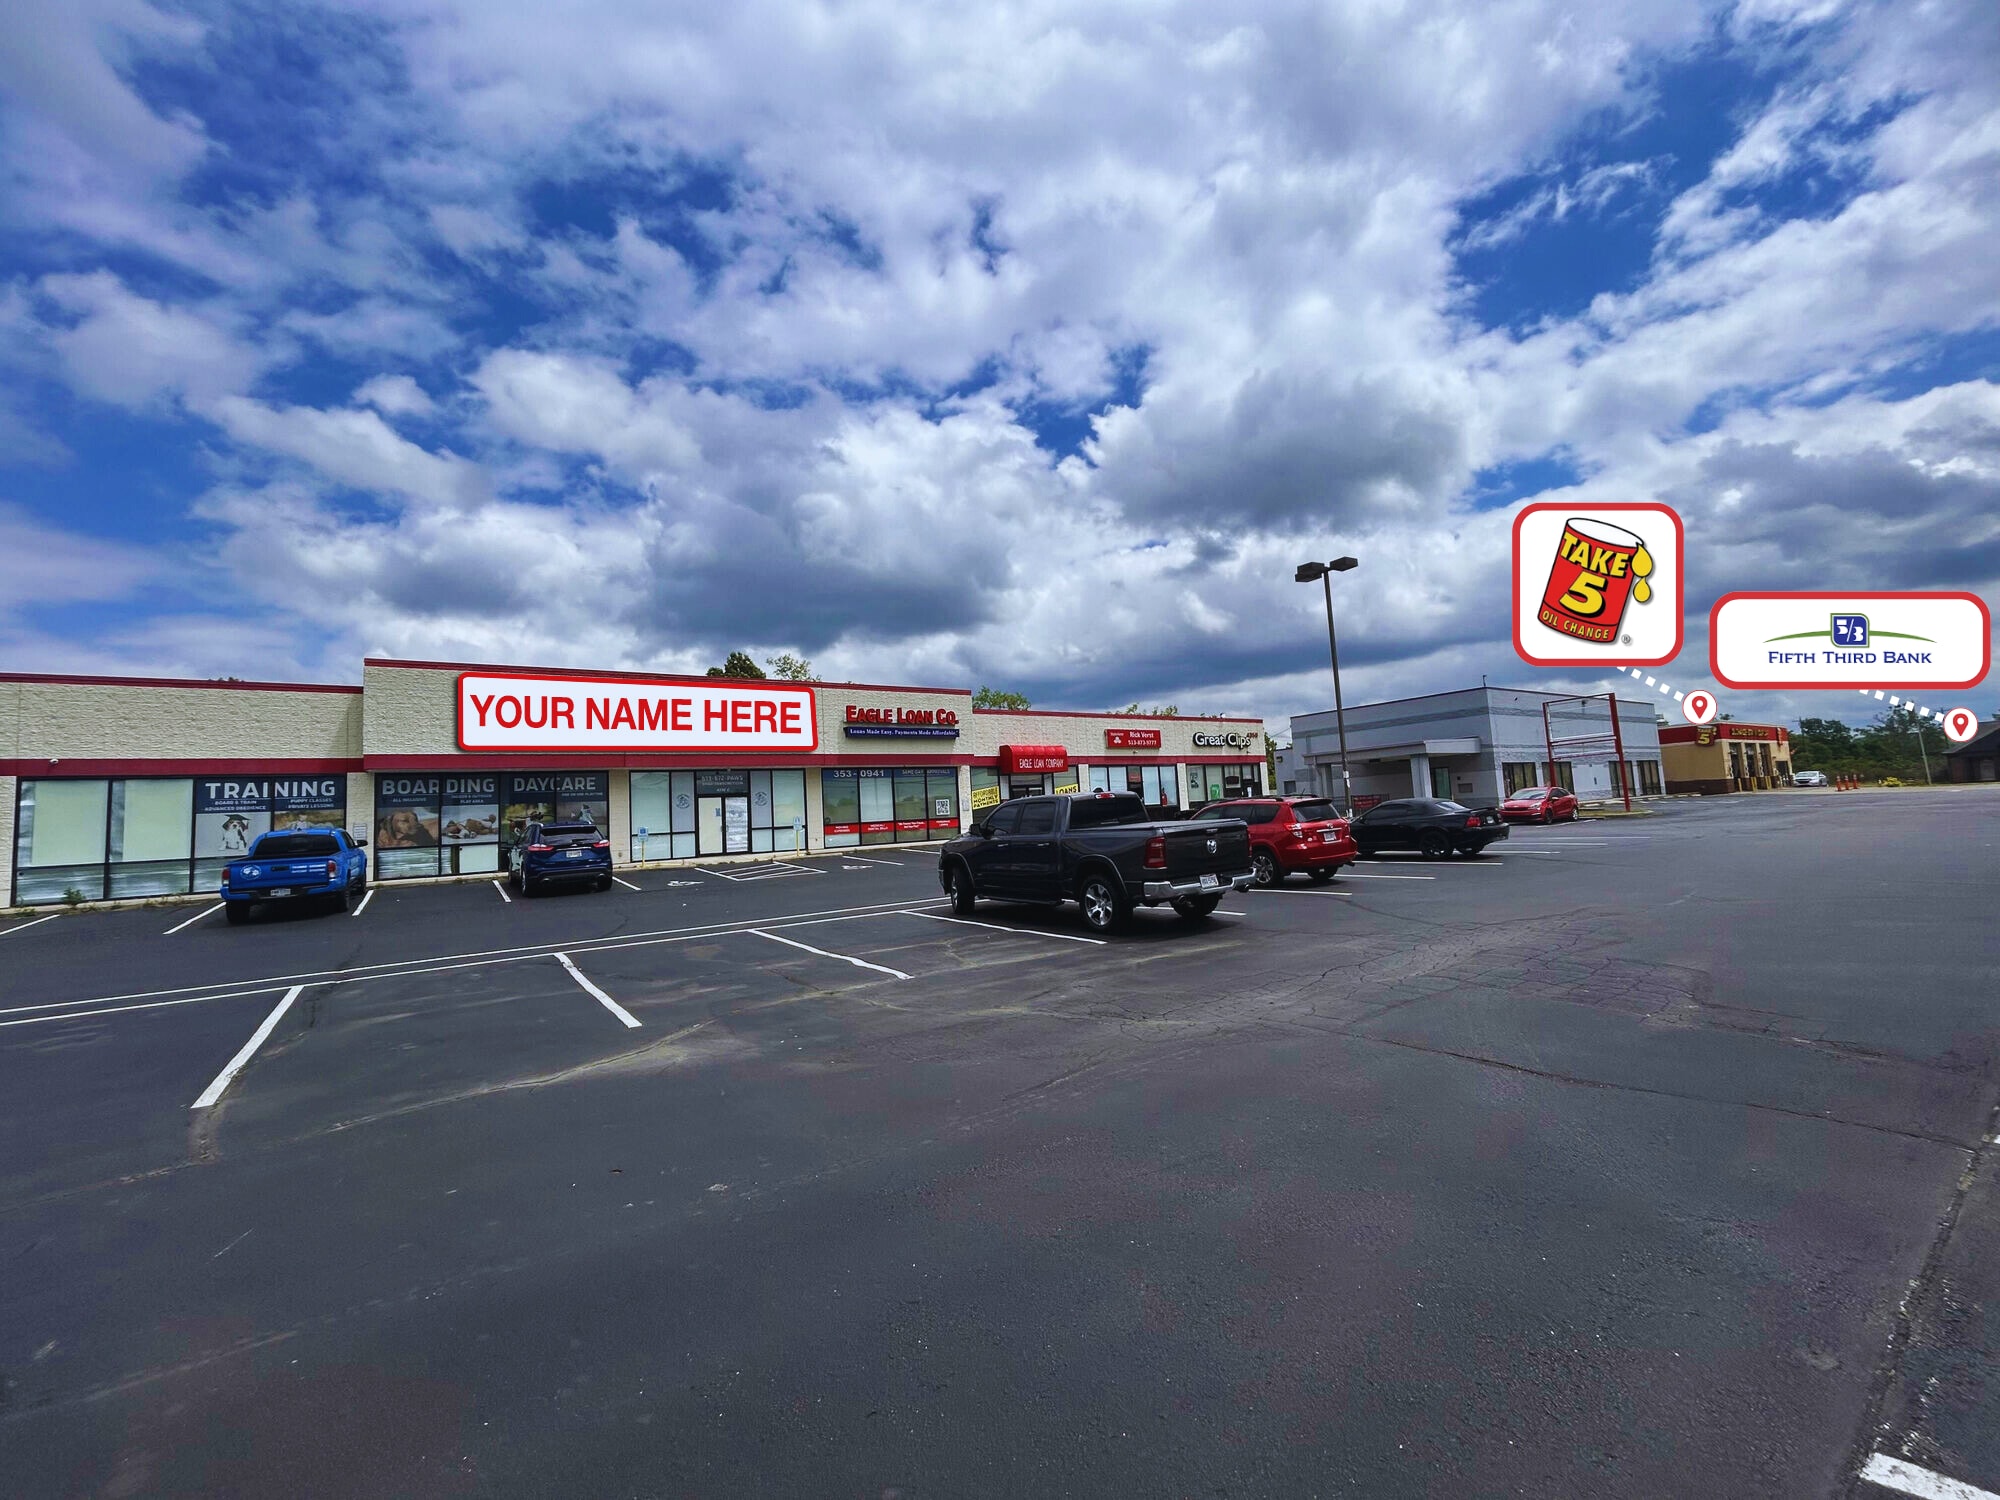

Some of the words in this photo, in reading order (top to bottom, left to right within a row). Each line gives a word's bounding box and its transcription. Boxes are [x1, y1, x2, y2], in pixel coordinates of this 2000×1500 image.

[846, 705, 893, 723] EAGLE
[897, 707, 933, 724] LOAN
[1194, 732, 1225, 746] Great
[1227, 733, 1251, 749] Clips
[1697, 733, 1710, 745] 5
[1018, 758, 1033, 769] EAGLE
[1034, 758, 1045, 769] LOAN
[205, 781, 336, 799] TRAINING
[382, 778, 496, 795] BOARDING
[513, 777, 596, 792] DAYCARE
